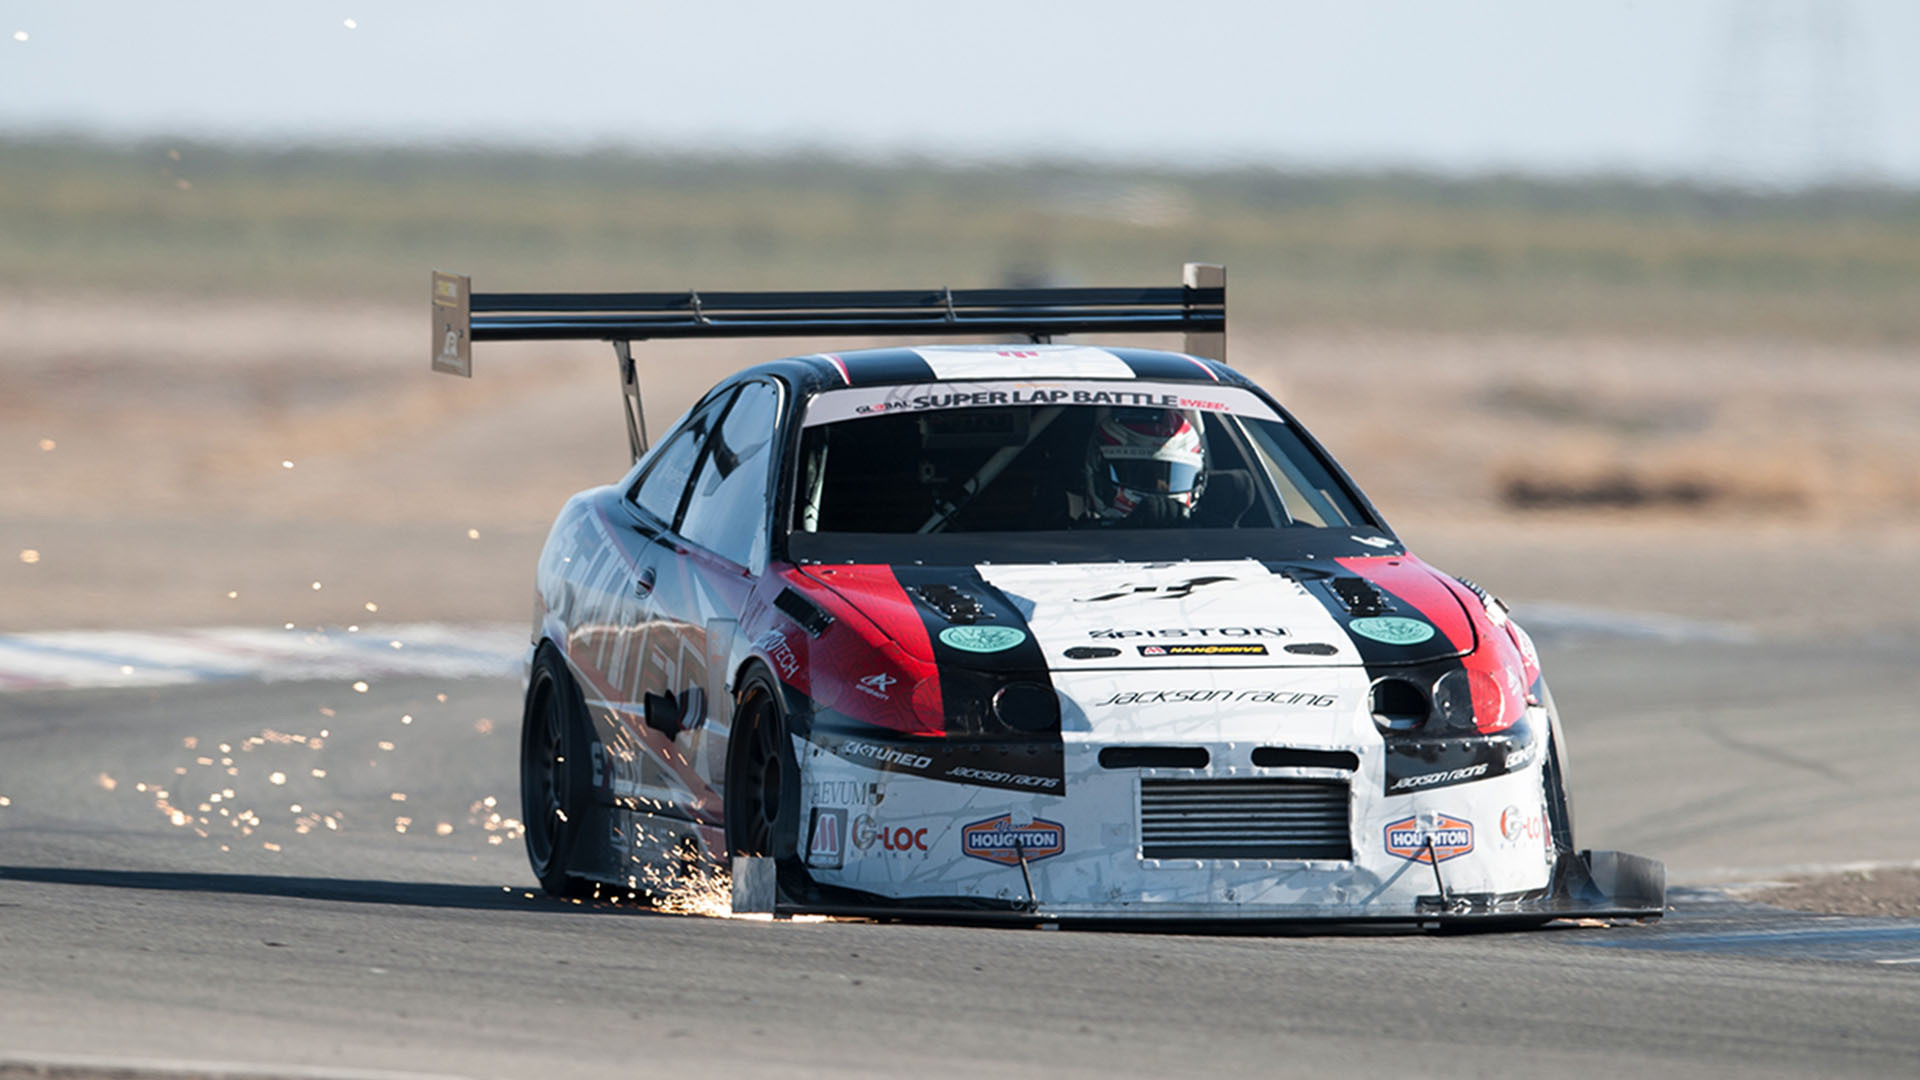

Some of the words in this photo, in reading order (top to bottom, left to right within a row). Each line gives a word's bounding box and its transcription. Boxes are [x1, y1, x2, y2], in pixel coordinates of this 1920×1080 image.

[913, 391, 1008, 409] SUPER
[1013, 390, 1069, 403] LAP
[1073, 391, 1178, 408] BATTLE
[851, 813, 928, 851] G-LOC
[971, 833, 1056, 847] HOUGHTON
